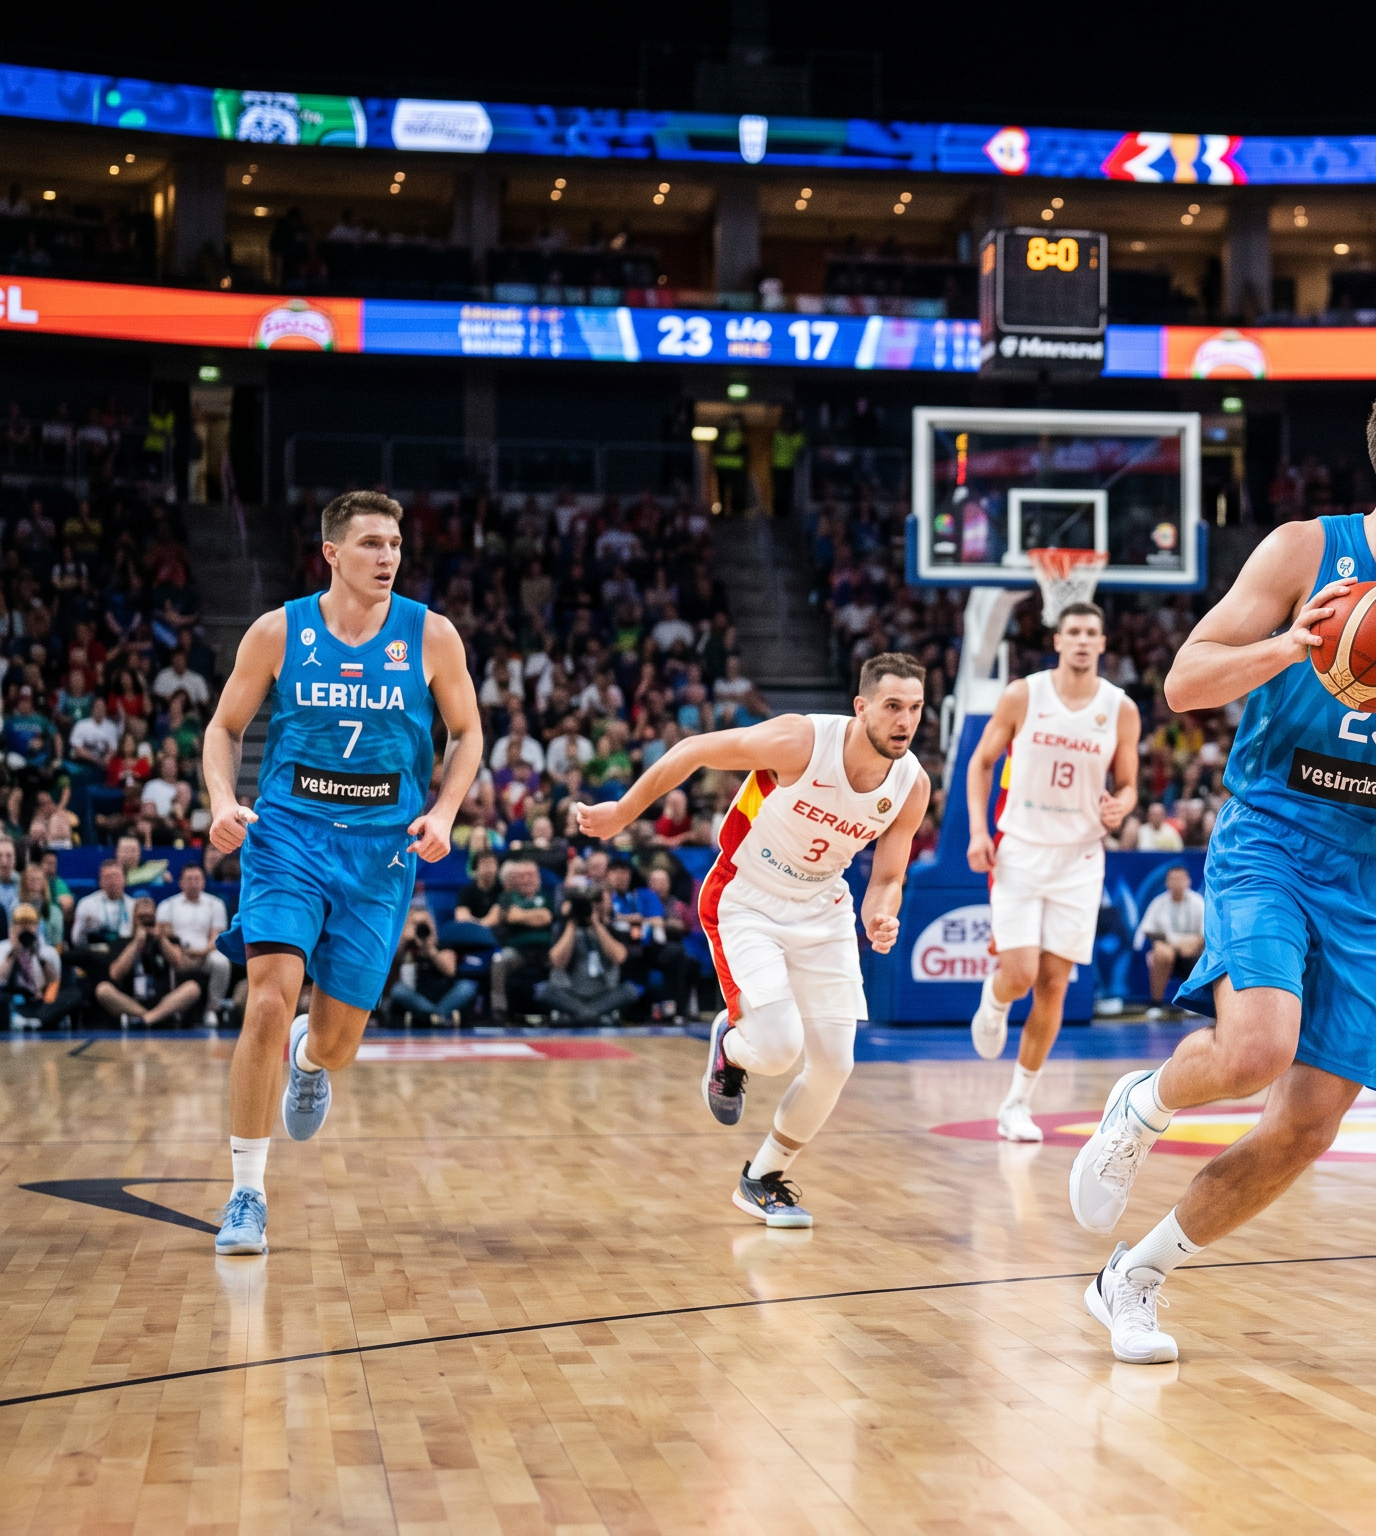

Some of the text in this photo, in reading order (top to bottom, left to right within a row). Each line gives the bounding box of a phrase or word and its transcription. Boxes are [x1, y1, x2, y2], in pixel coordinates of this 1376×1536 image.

[0, 285, 39, 325] L
[657, 315, 713, 358] 23
[788, 320, 839, 361] 17
[338, 720, 363, 759] 7
[1050, 760, 1075, 789] 13
[803, 838, 830, 863] 3
